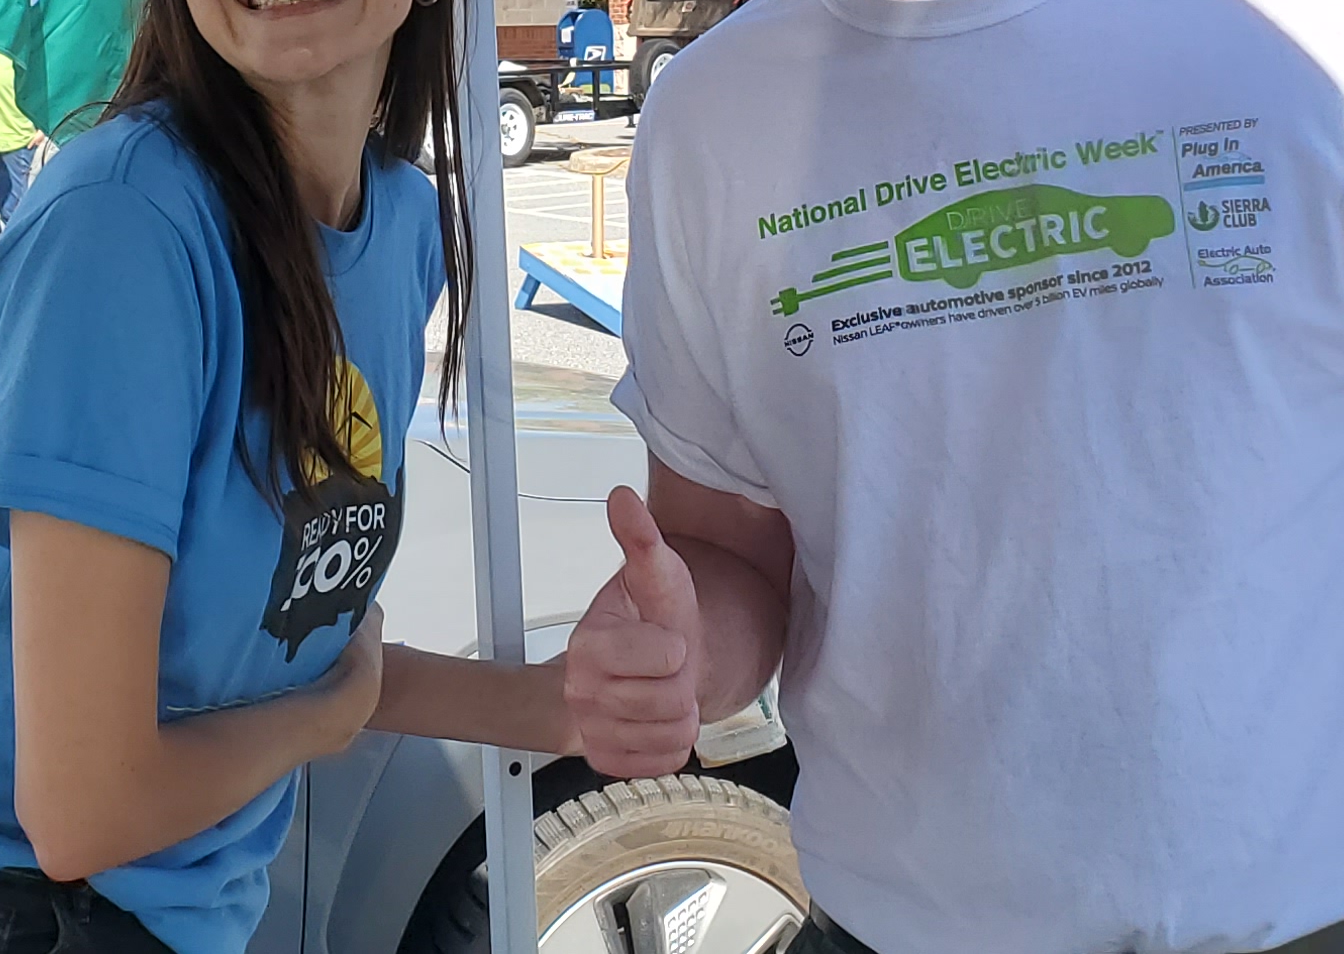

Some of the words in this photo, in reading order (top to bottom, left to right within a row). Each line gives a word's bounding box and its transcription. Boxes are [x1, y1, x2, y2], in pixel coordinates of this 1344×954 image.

[1179, 119, 1242, 136] PRESENTED
[1244, 118, 1259, 128] BY
[1181, 141, 1218, 158] Plug
[1224, 137, 1239, 152] In
[758, 188, 867, 239] National
[875, 172, 947, 207] Drive
[953, 147, 1067, 187] Electric
[1221, 197, 1271, 214] SIERRA
[946, 199, 1033, 230] DRIVE
[1223, 213, 1256, 228] CLUB
[905, 205, 1110, 274] ELECTRIC
[1198, 246, 1241, 259] Electric
[1244, 244, 1272, 256] Auto
[1204, 273, 1274, 287] Association
[831, 306, 902, 332] Exclusive
[906, 289, 1004, 314] automotive
[1008, 274, 1064, 301] sponsor
[1067, 269, 1108, 285] since
[1112, 260, 1152, 277] 2012
[833, 325, 868, 345] Nissan
[949, 311, 976, 325] have
[978, 305, 1012, 319] driven
[1014, 299, 1033, 313] over
[1072, 287, 1087, 298] EV
[1089, 284, 1118, 296] miles
[1120, 275, 1165, 293] globally
[784, 330, 814, 347] NISSAN
[346, 503, 386, 533] FOR
[683, 820, 779, 855] Hankoo
